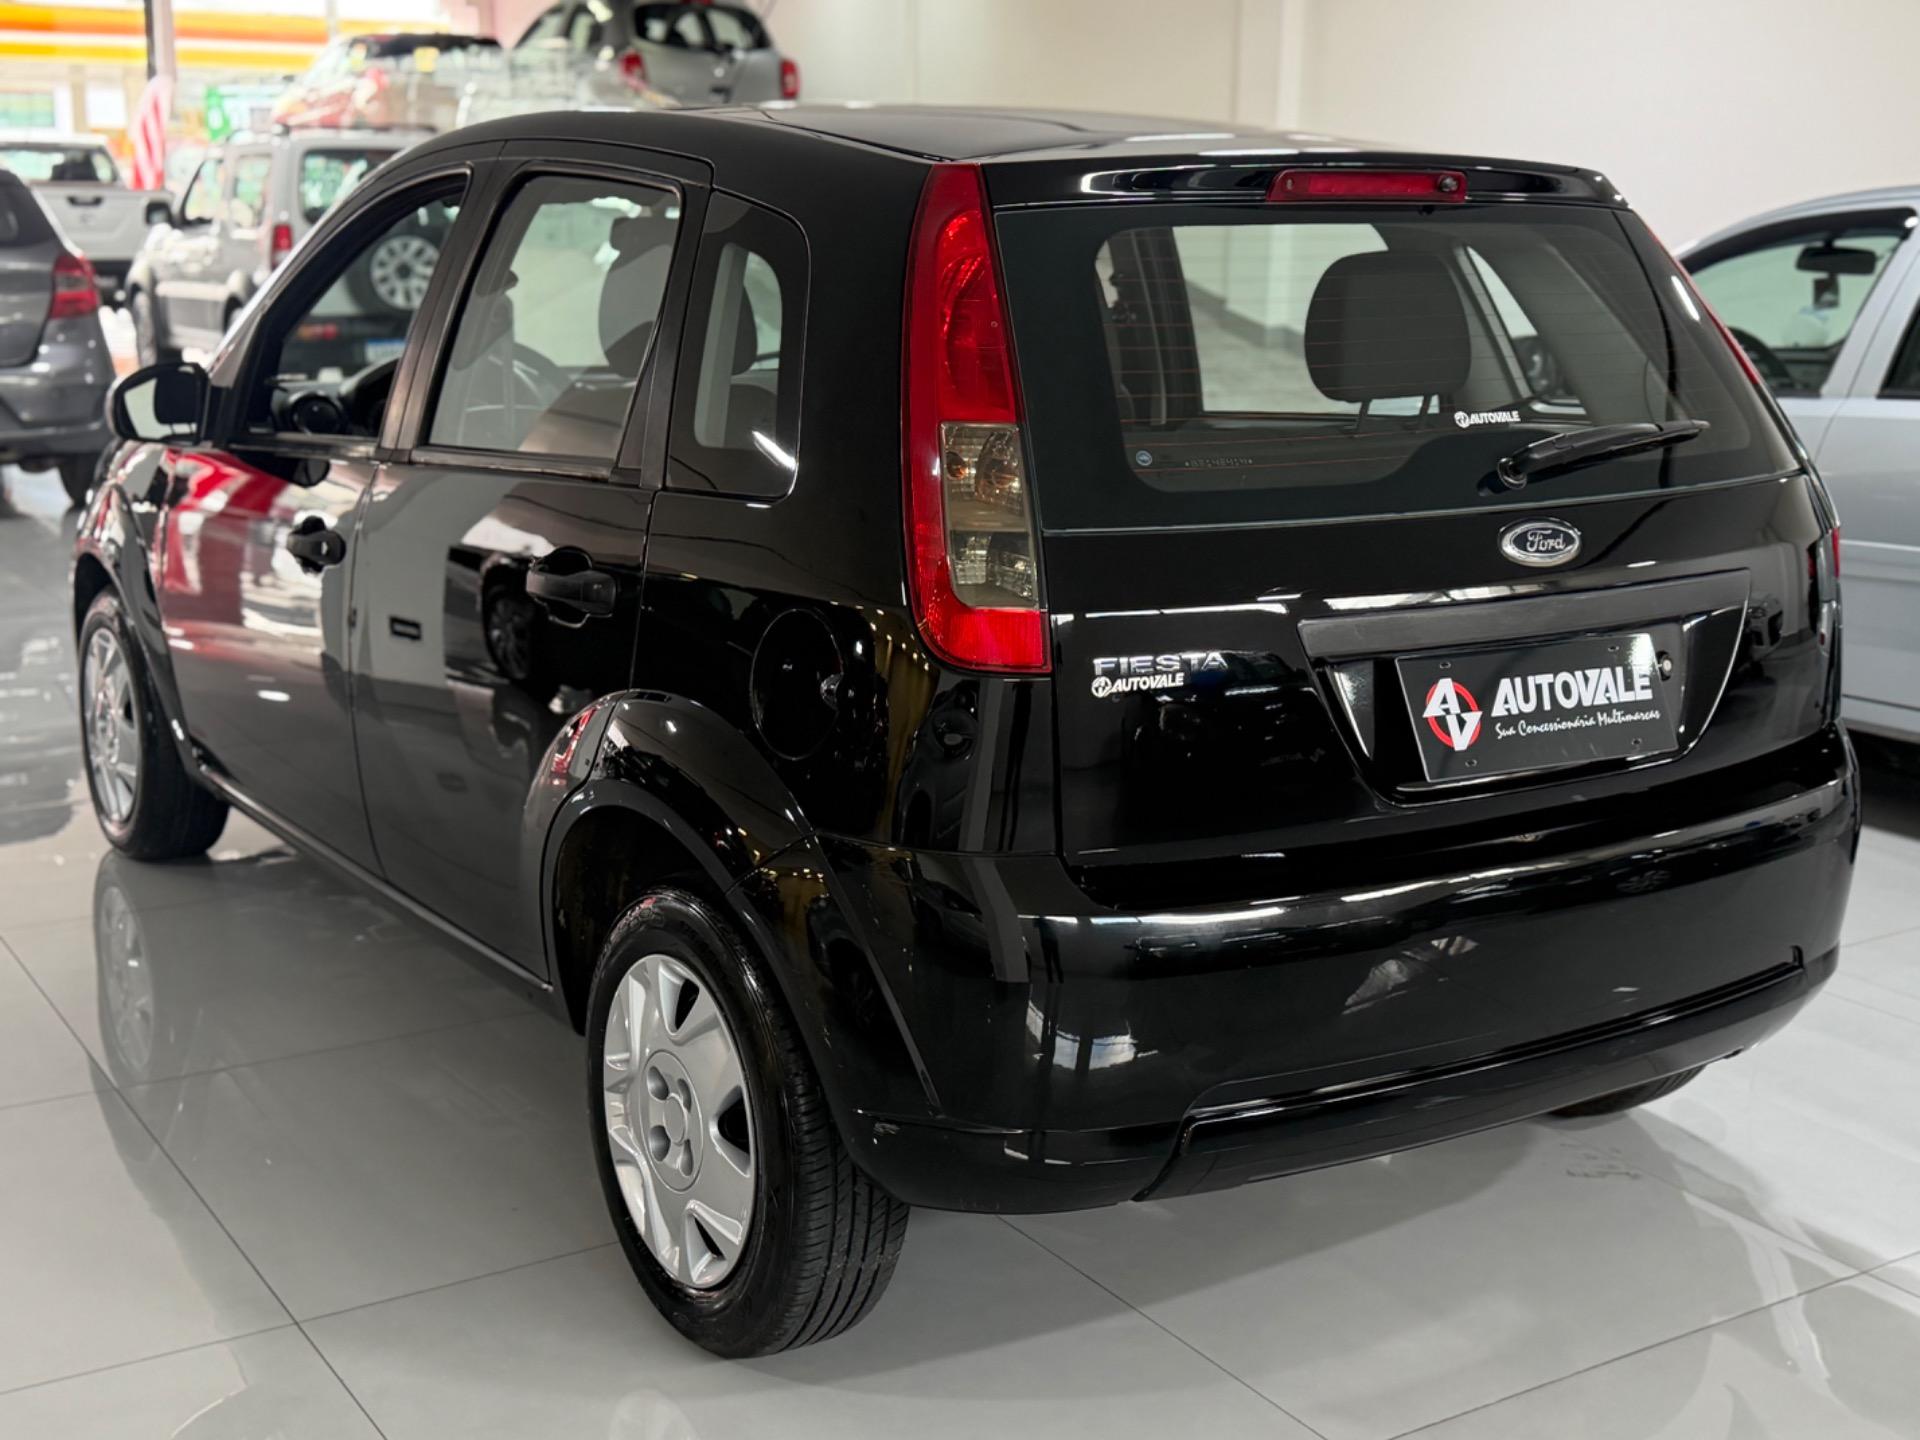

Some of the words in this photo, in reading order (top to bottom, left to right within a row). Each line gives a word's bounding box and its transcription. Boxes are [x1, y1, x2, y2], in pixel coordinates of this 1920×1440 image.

[1468, 410, 1521, 425] AUTOVALE
[1526, 529, 1566, 552] Ford
[1093, 652, 1229, 676] FIESTA
[1108, 672, 1185, 694] AUTOVALE
[1491, 666, 1654, 717] AUTOVALE
[1494, 722, 1517, 740] Sua
[1517, 714, 1597, 737] Concessionária
[1596, 708, 1662, 727] Multimarcas
